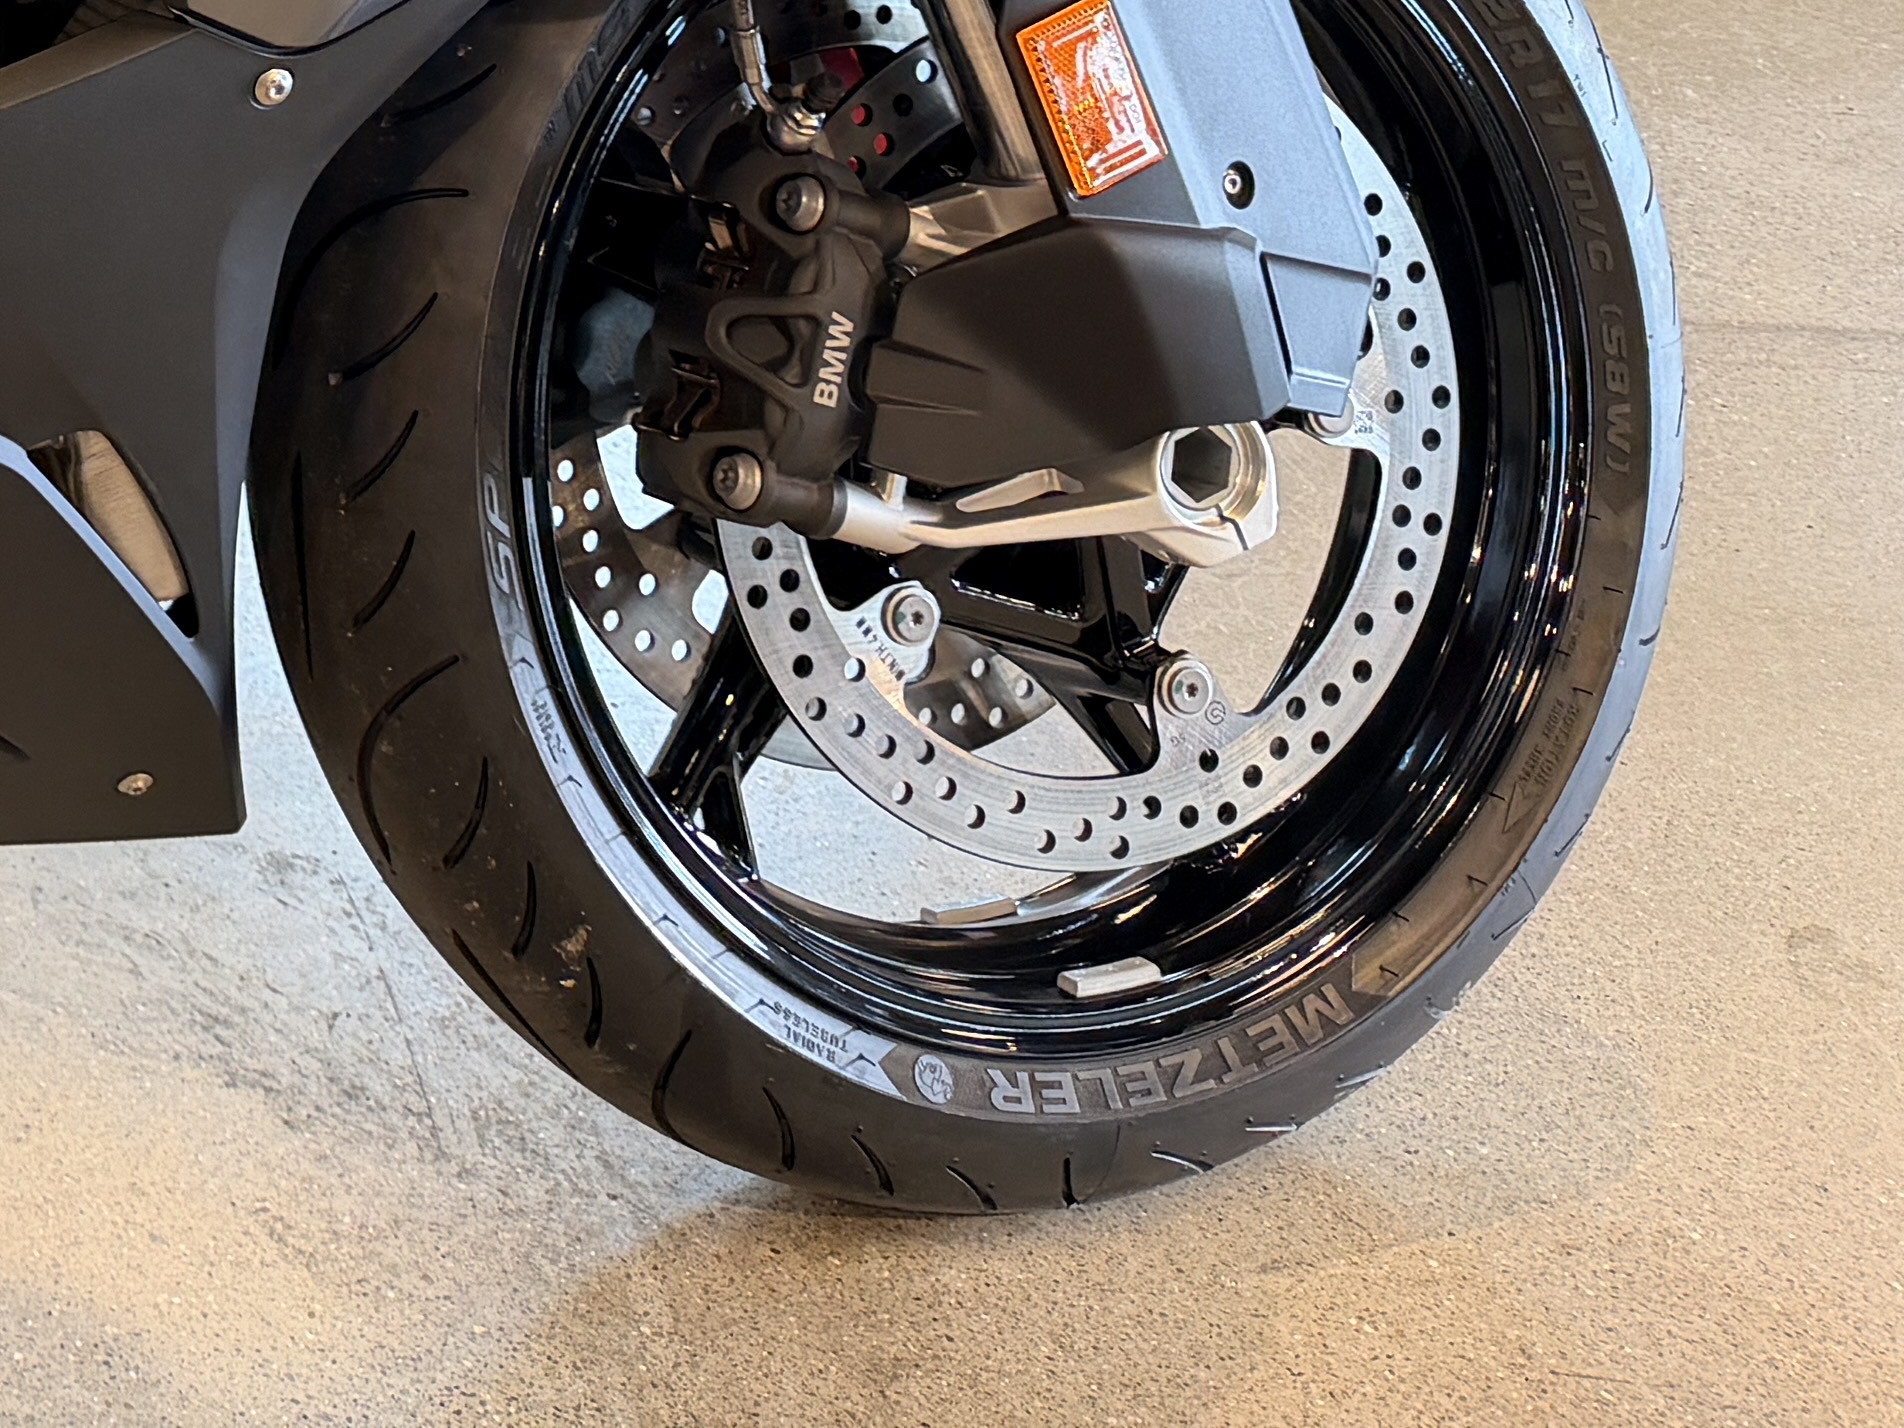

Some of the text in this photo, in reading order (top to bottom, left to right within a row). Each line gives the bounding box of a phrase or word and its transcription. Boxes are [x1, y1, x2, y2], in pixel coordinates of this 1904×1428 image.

[810, 310, 857, 408] BMW
[782, 1024, 838, 1065] RADIAL
[988, 982, 1356, 1118] METZELER
